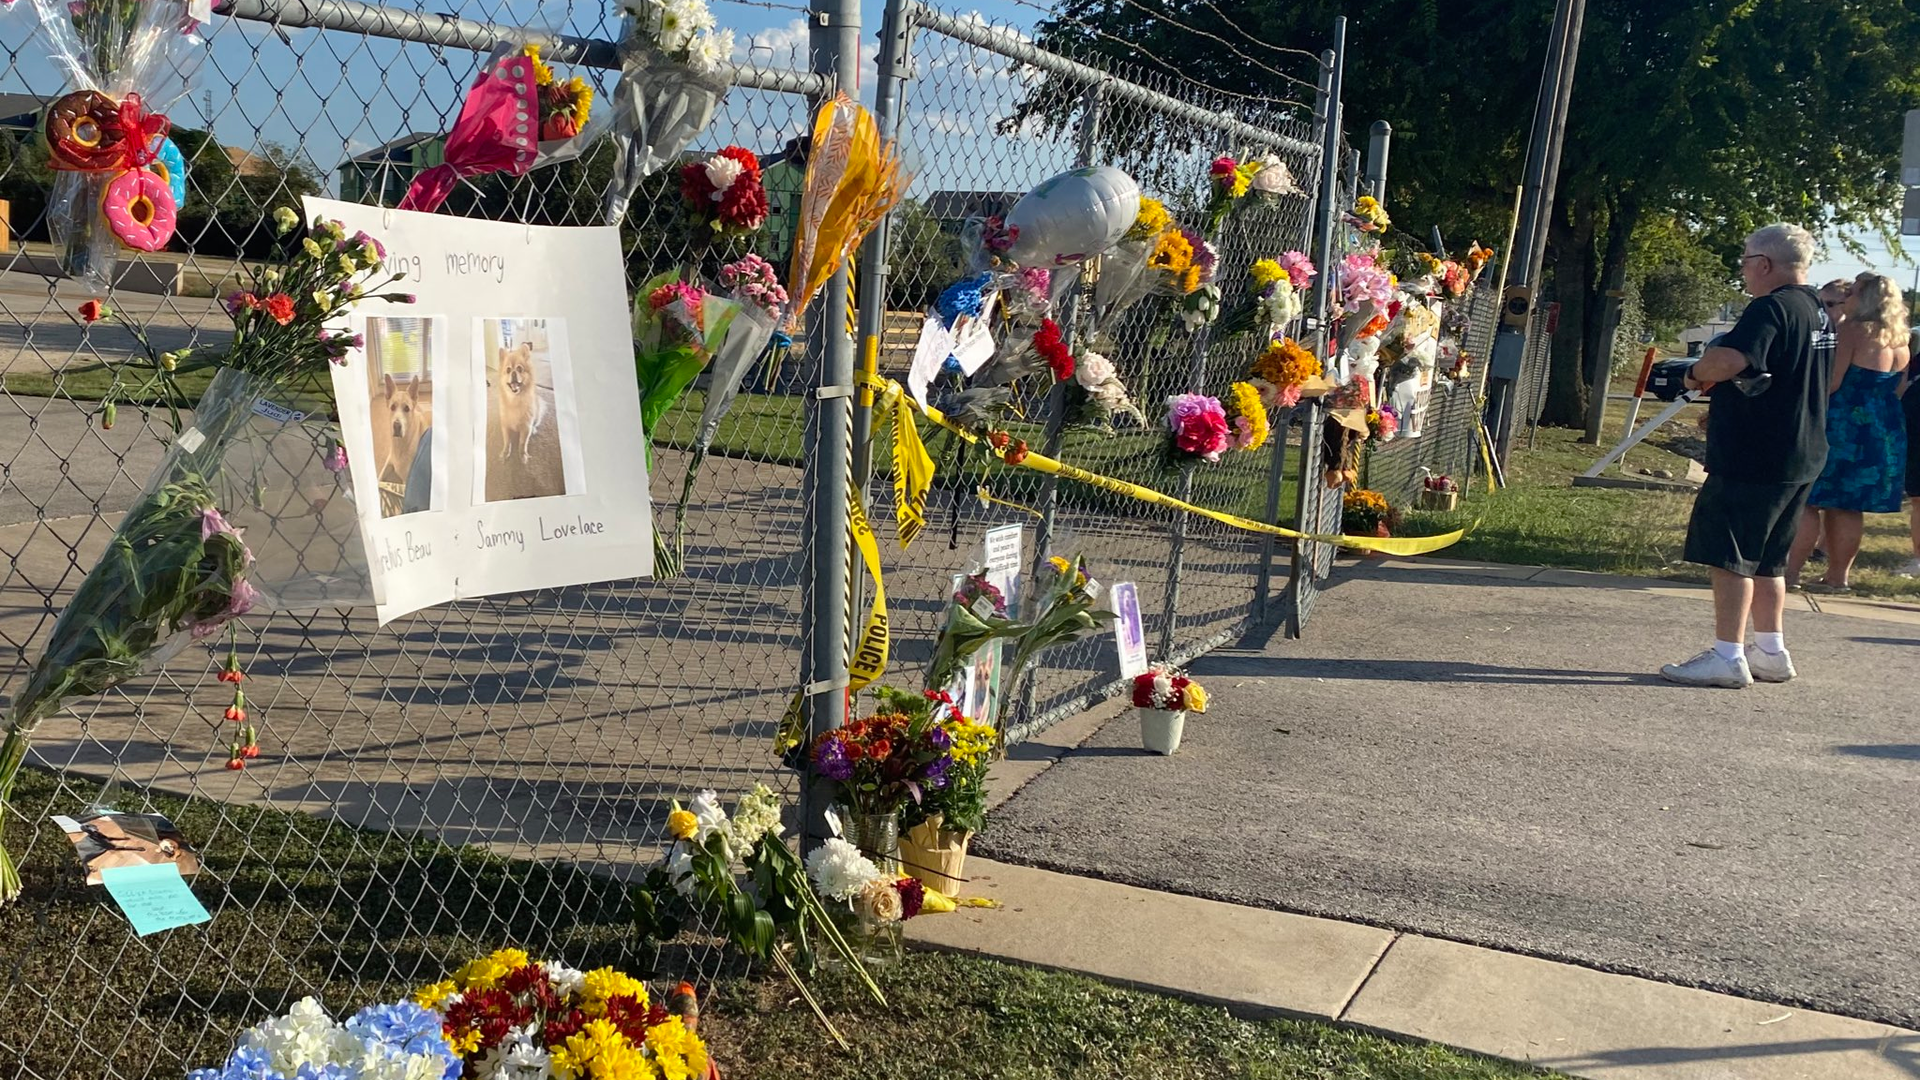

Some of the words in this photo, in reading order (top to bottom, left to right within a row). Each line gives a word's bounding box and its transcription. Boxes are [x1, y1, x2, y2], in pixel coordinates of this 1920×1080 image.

[381, 251, 421, 283] ving
[446, 251, 505, 283] memory
[405, 530, 431, 562] Beau
[476, 519, 525, 552] Sammy
[539, 514, 604, 541] Lovelace
[853, 613, 886, 673] POLICE
